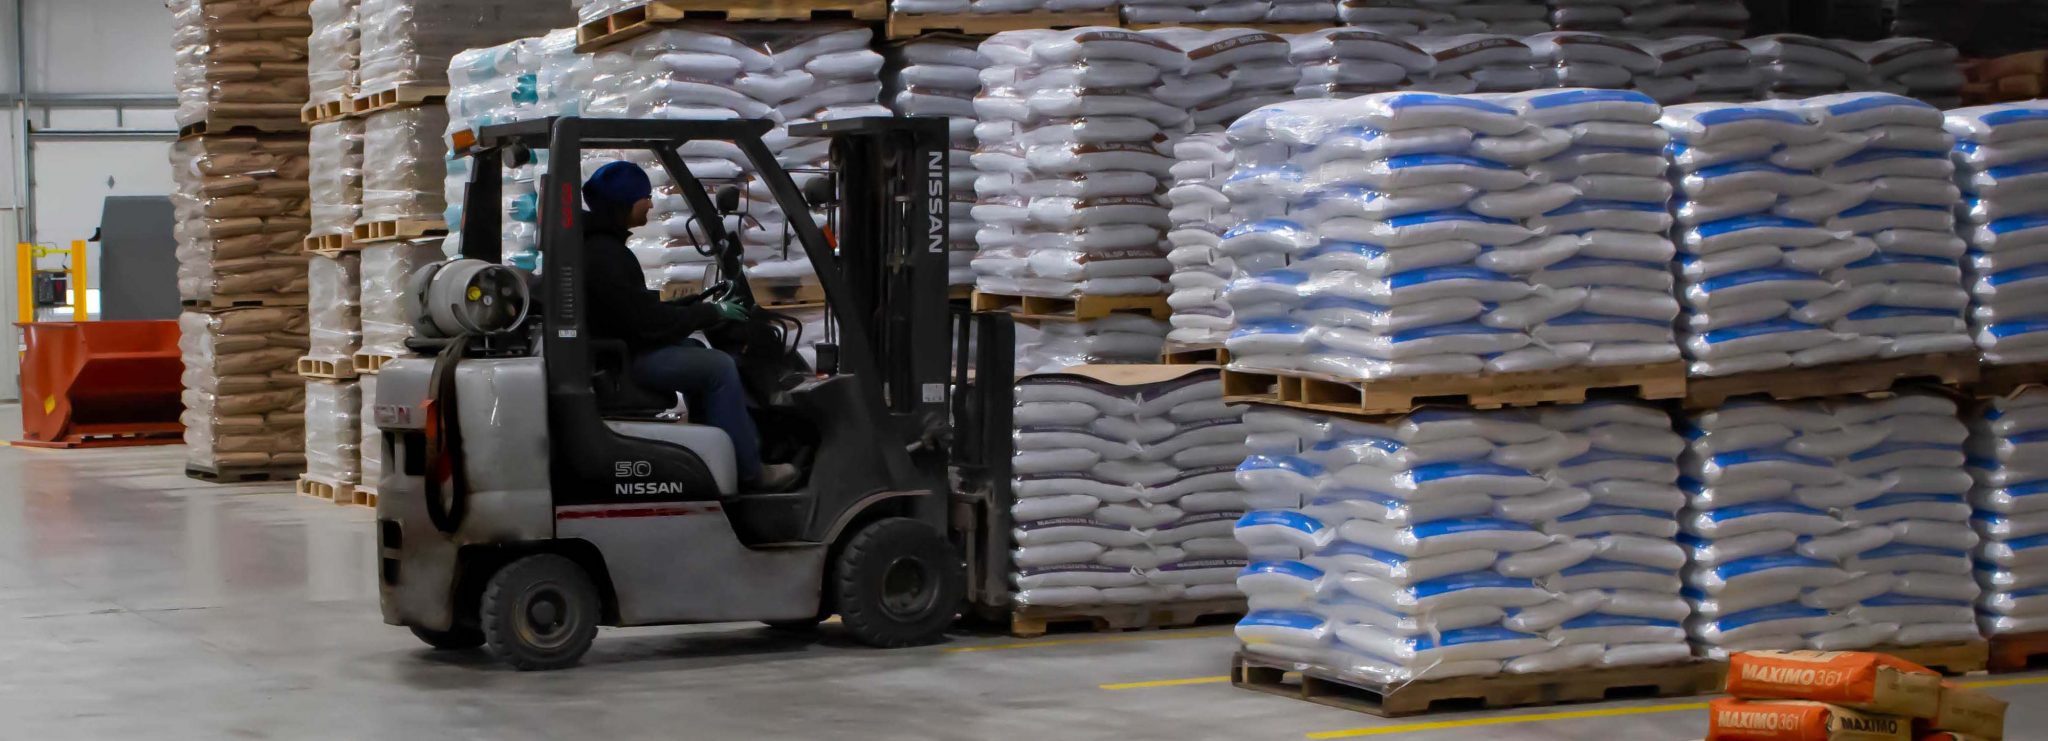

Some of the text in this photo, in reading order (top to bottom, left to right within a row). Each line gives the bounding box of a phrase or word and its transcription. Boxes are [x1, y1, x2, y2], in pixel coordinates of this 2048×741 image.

[928, 151, 943, 253] NISSAN
[615, 461, 652, 477] 50
[615, 482, 683, 495] NISSAN
[1840, 717, 1898, 734] MAXIMO
